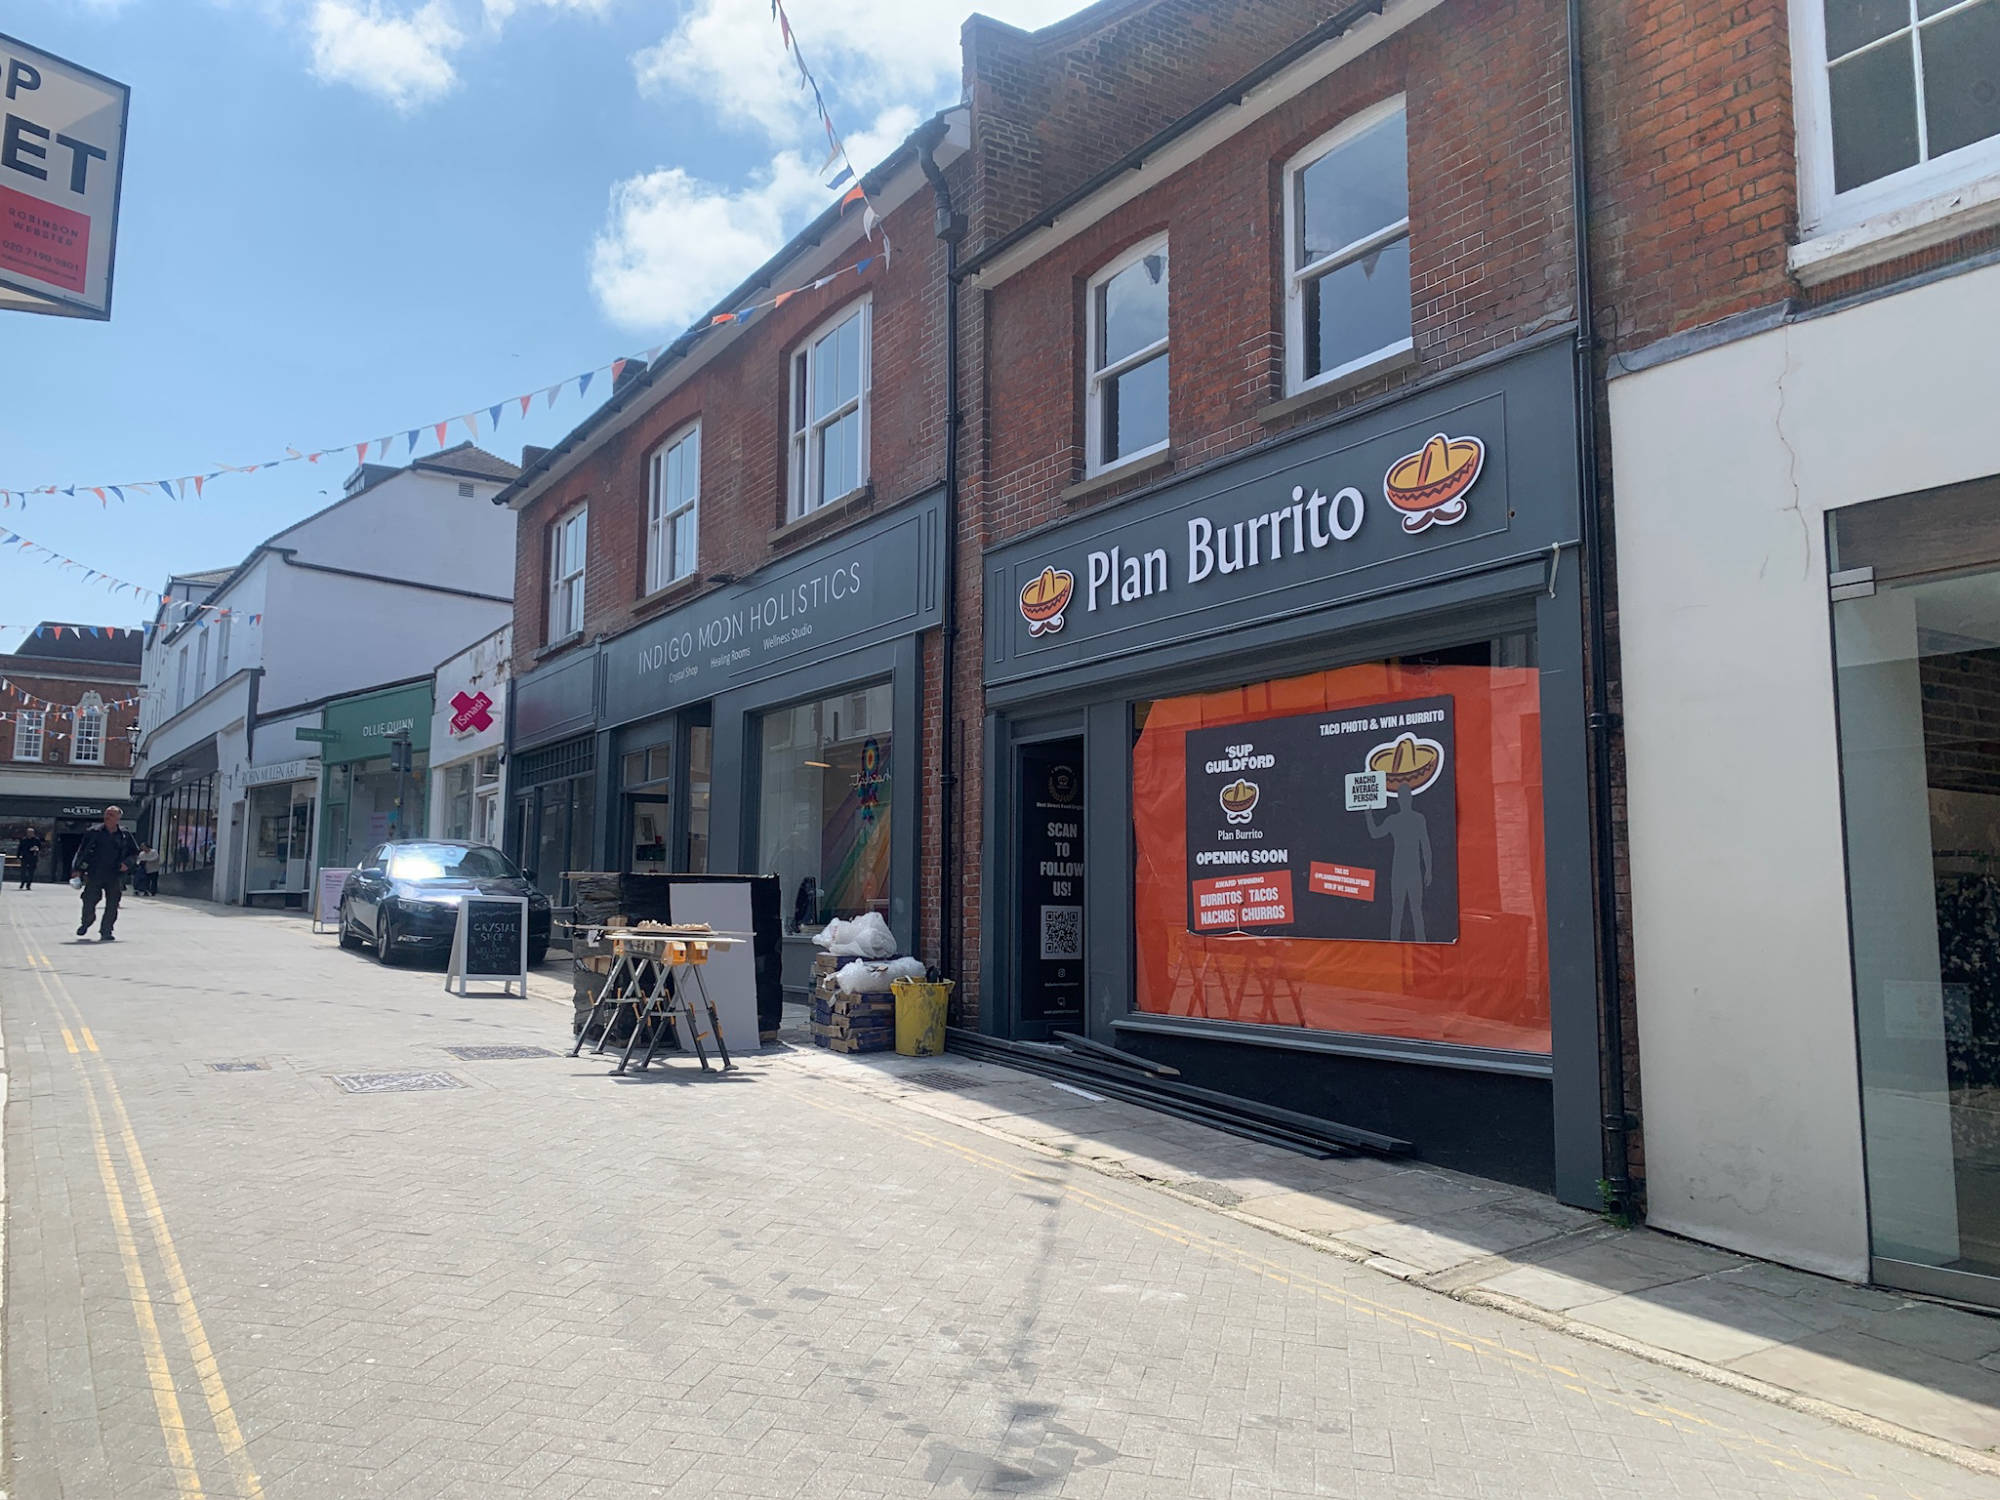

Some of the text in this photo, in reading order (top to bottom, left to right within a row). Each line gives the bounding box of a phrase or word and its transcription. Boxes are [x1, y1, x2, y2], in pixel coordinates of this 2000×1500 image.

[0, 58, 42, 101] P
[8, 207, 79, 238] ROBINSON
[14, 222, 73, 247] WEBSTER
[1087, 485, 1365, 611] Plan Burrito
[638, 561, 861, 675] INDIGO MOON HOLISTICS
[763, 623, 813, 650] Wellness Studio
[711, 647, 751, 668] Healing Rooms
[685, 664, 698, 678] Shop
[362, 722, 386, 737] OLLIE
[1320, 709, 1445, 736] TACO PHOTO & WIN A BURRITO
[1205, 754, 1275, 774] GUILDFORD
[1354, 775, 1376, 785] NACHO
[1352, 784, 1379, 794] AVERAGE
[1353, 793, 1378, 803] PERSON
[1047, 822, 1077, 838] SCAN
[1217, 828, 1263, 841] Plan Burrito
[1055, 842, 1070, 857] TO
[1196, 849, 1288, 865] OPENING SOON
[1040, 861, 1084, 877] FOLLOW
[1053, 881, 1071, 896] US!
[1215, 876, 1265, 889] AWARD WINNING
[1200, 887, 1279, 907] BURRITOS TACOS
[1201, 905, 1285, 925] NACHOS CHURROS
[473, 922, 517, 933] CRYSTAL
